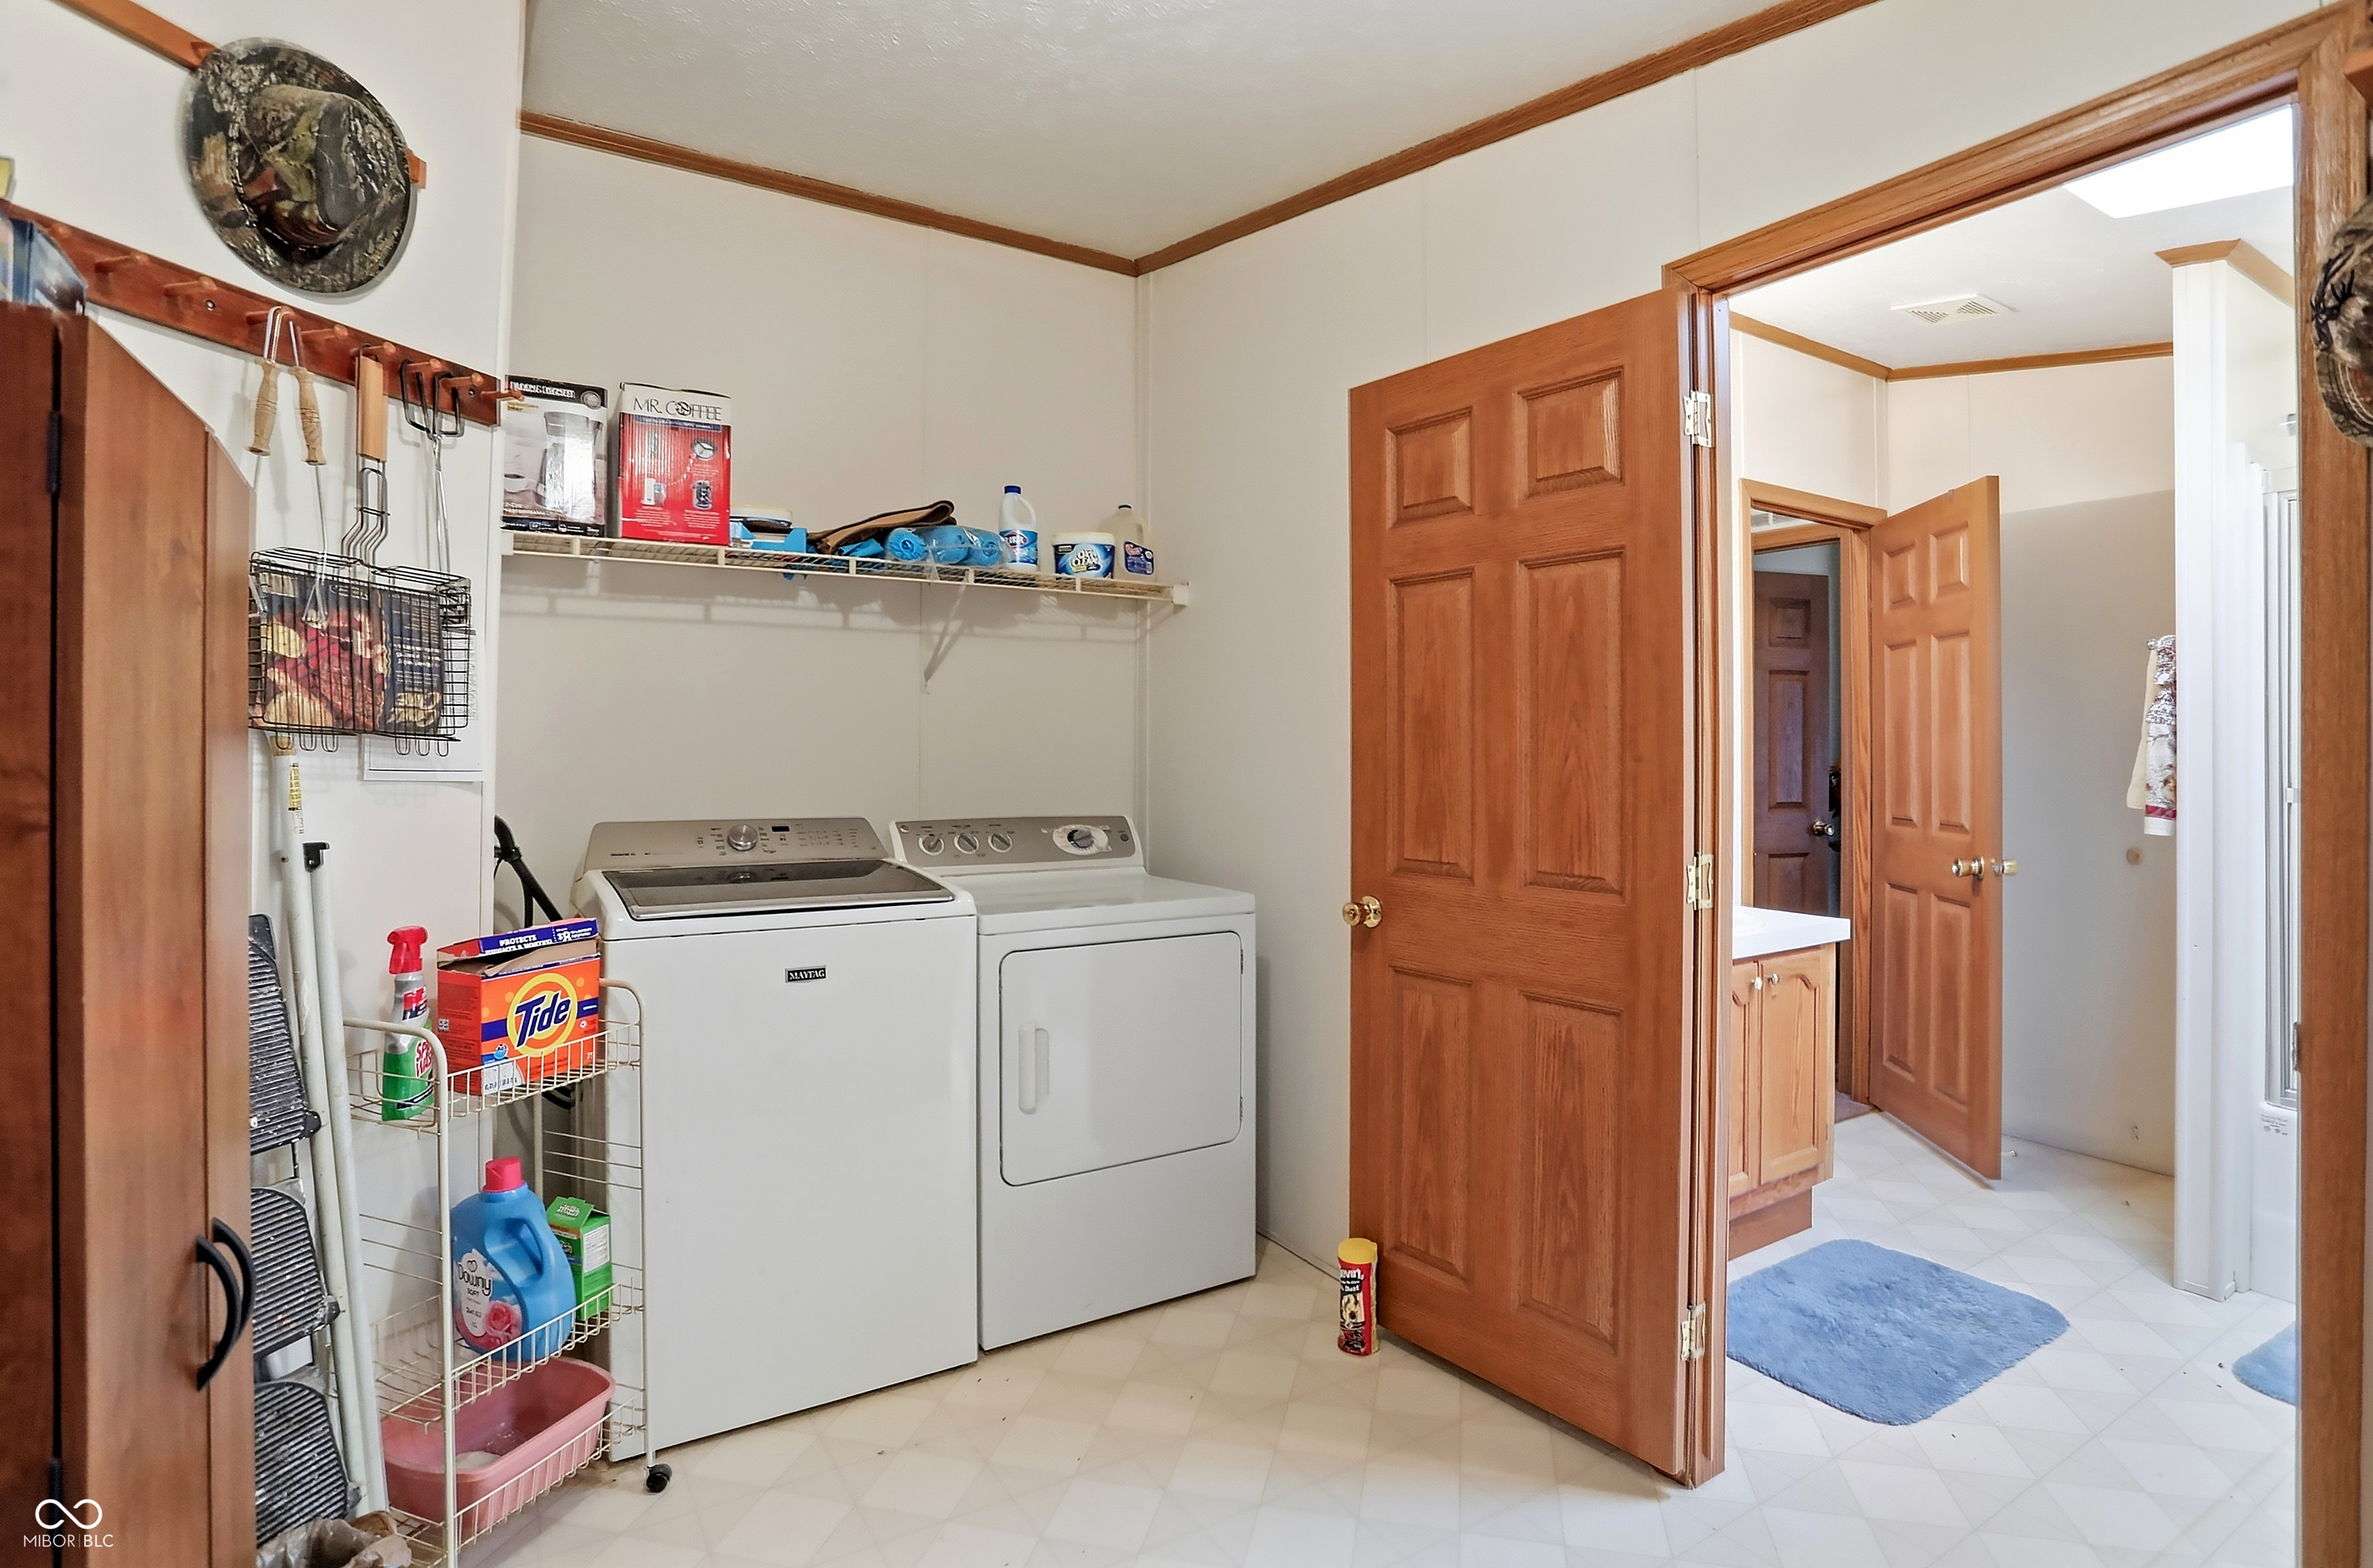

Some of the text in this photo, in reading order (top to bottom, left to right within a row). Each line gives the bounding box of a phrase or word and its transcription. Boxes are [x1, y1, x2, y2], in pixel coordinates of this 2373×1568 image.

[633, 397, 722, 422] MR. COFFEE
[789, 969, 825, 980] MAYTAG
[514, 990, 571, 1049] Tide
[458, 1264, 491, 1296] Downy
